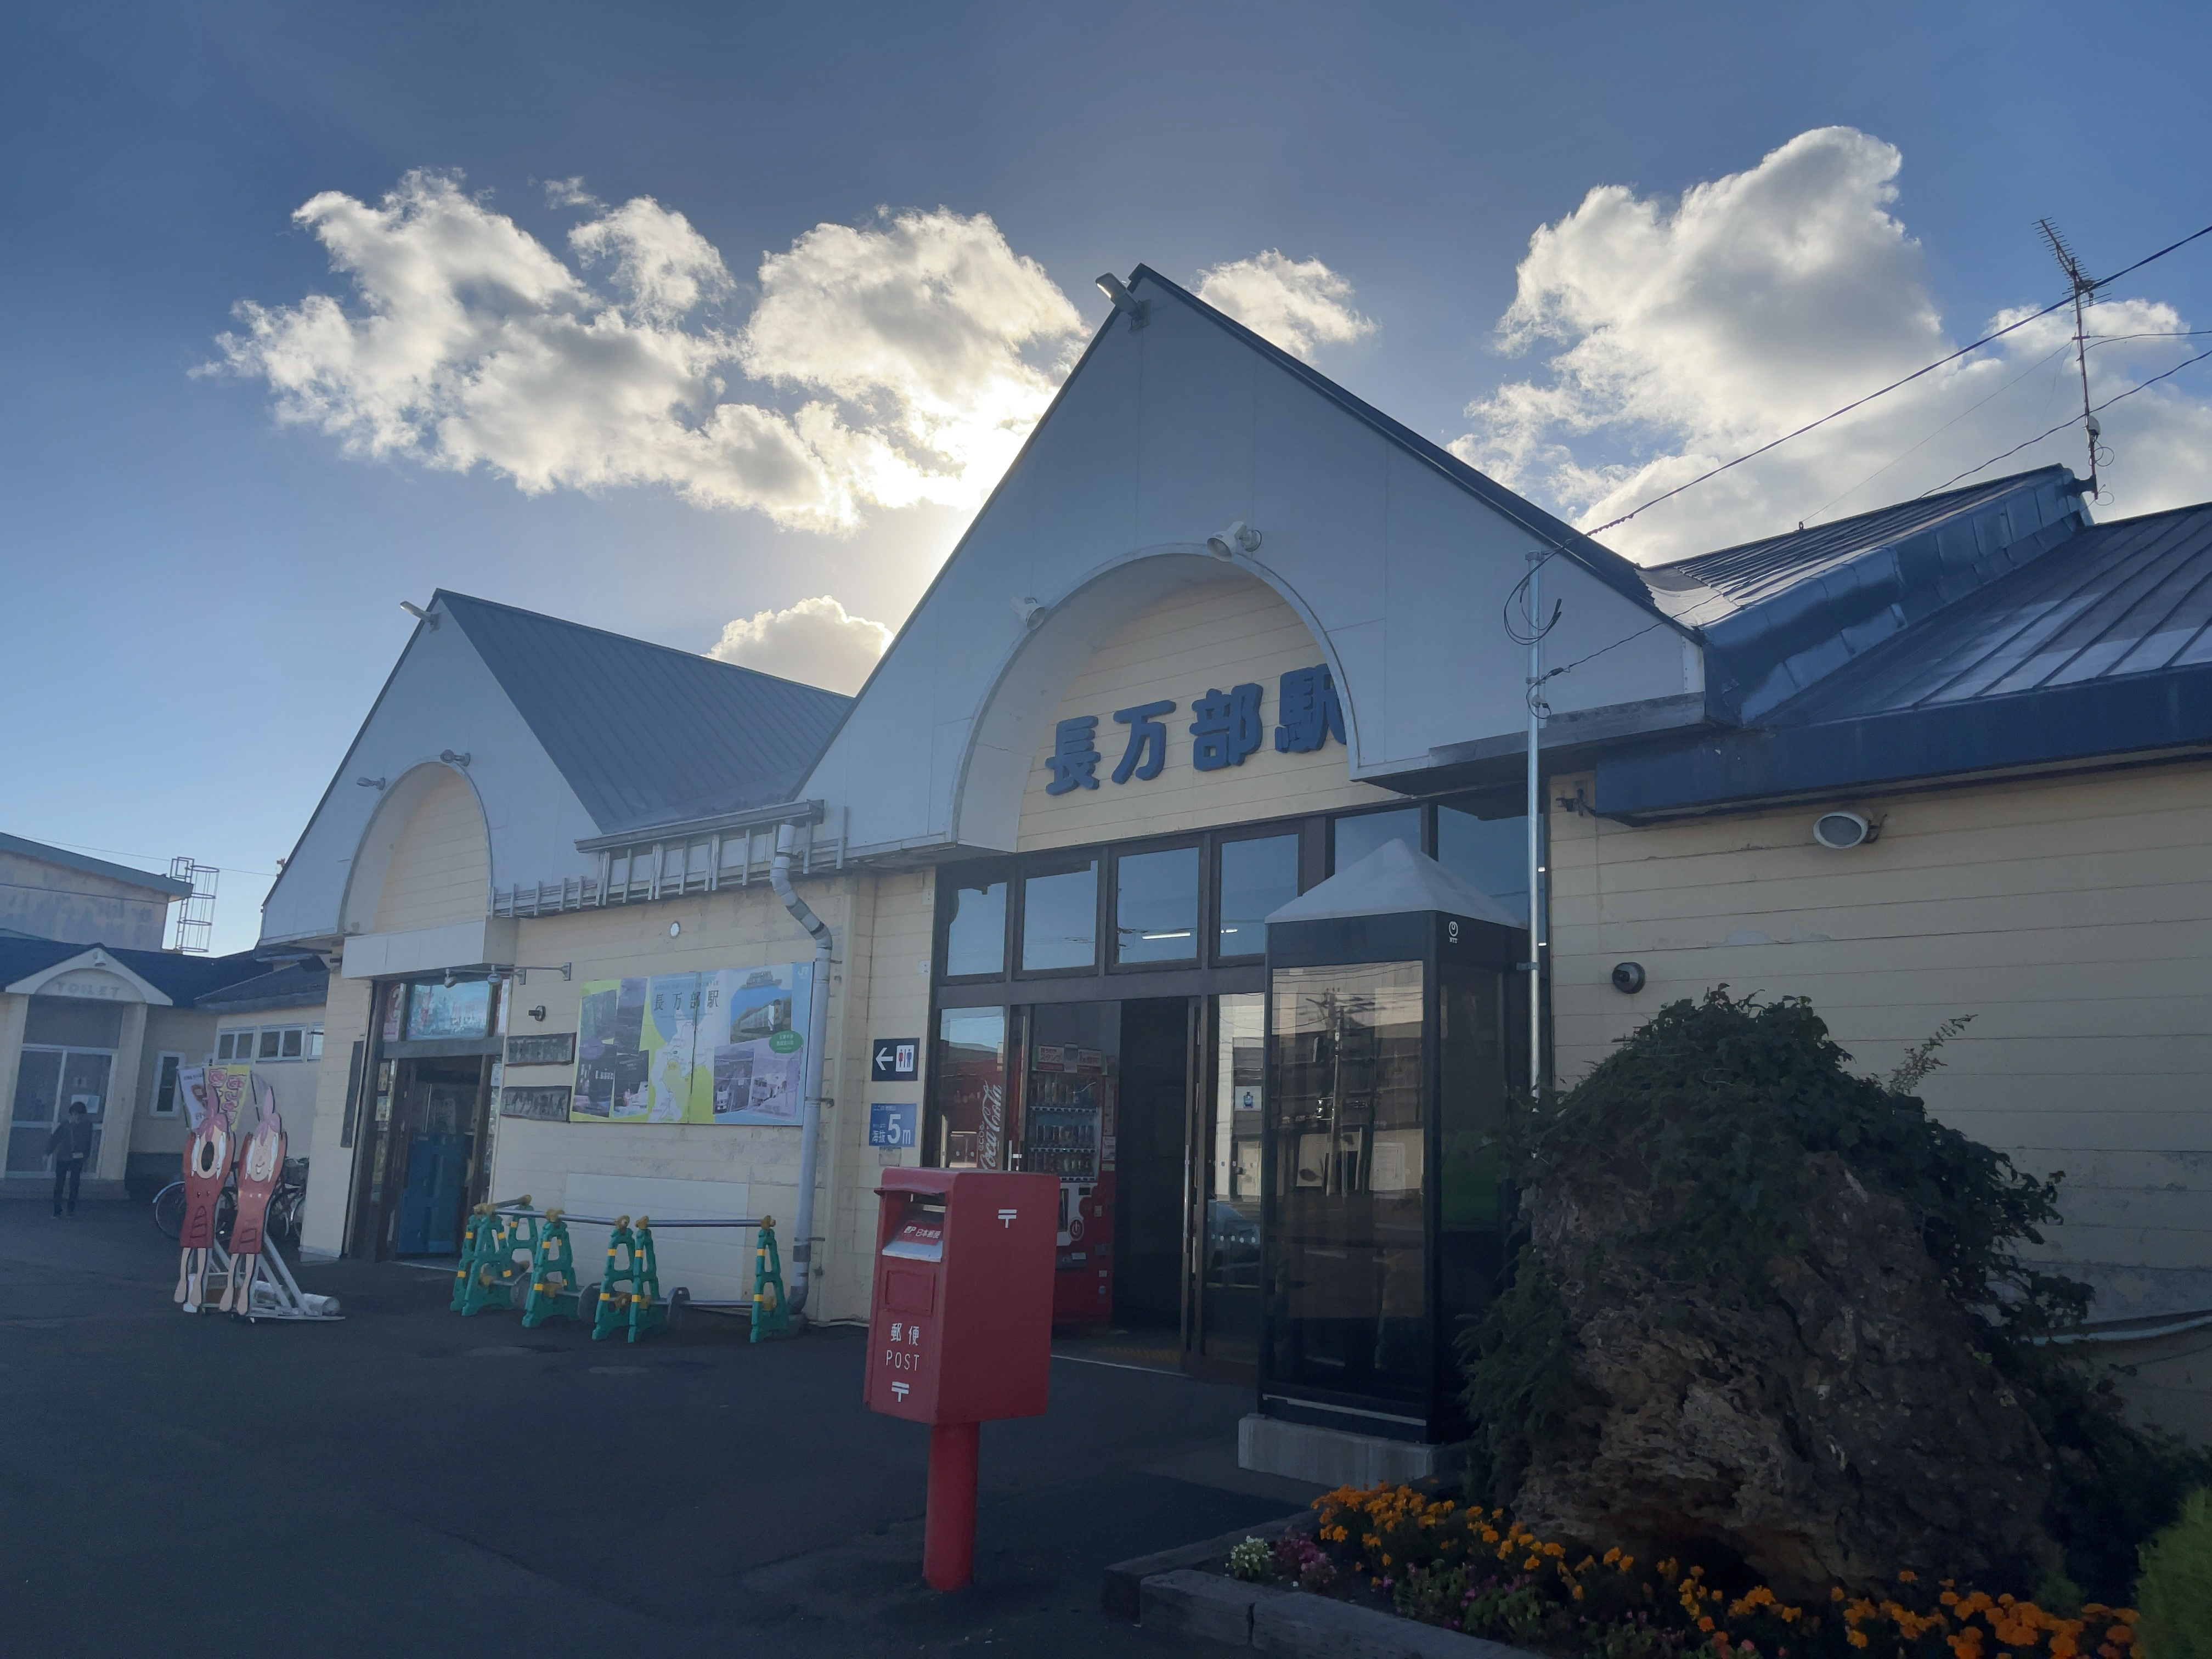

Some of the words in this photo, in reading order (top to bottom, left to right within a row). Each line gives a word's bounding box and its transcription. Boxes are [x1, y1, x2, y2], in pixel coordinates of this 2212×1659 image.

[1045, 663, 1346, 795] 長万部駅
[57, 981, 120, 998] TOILET
[654, 990, 719, 1011] 長万部駅
[891, 1323, 919, 1346] 郵便
[885, 1350, 919, 1371] POST
